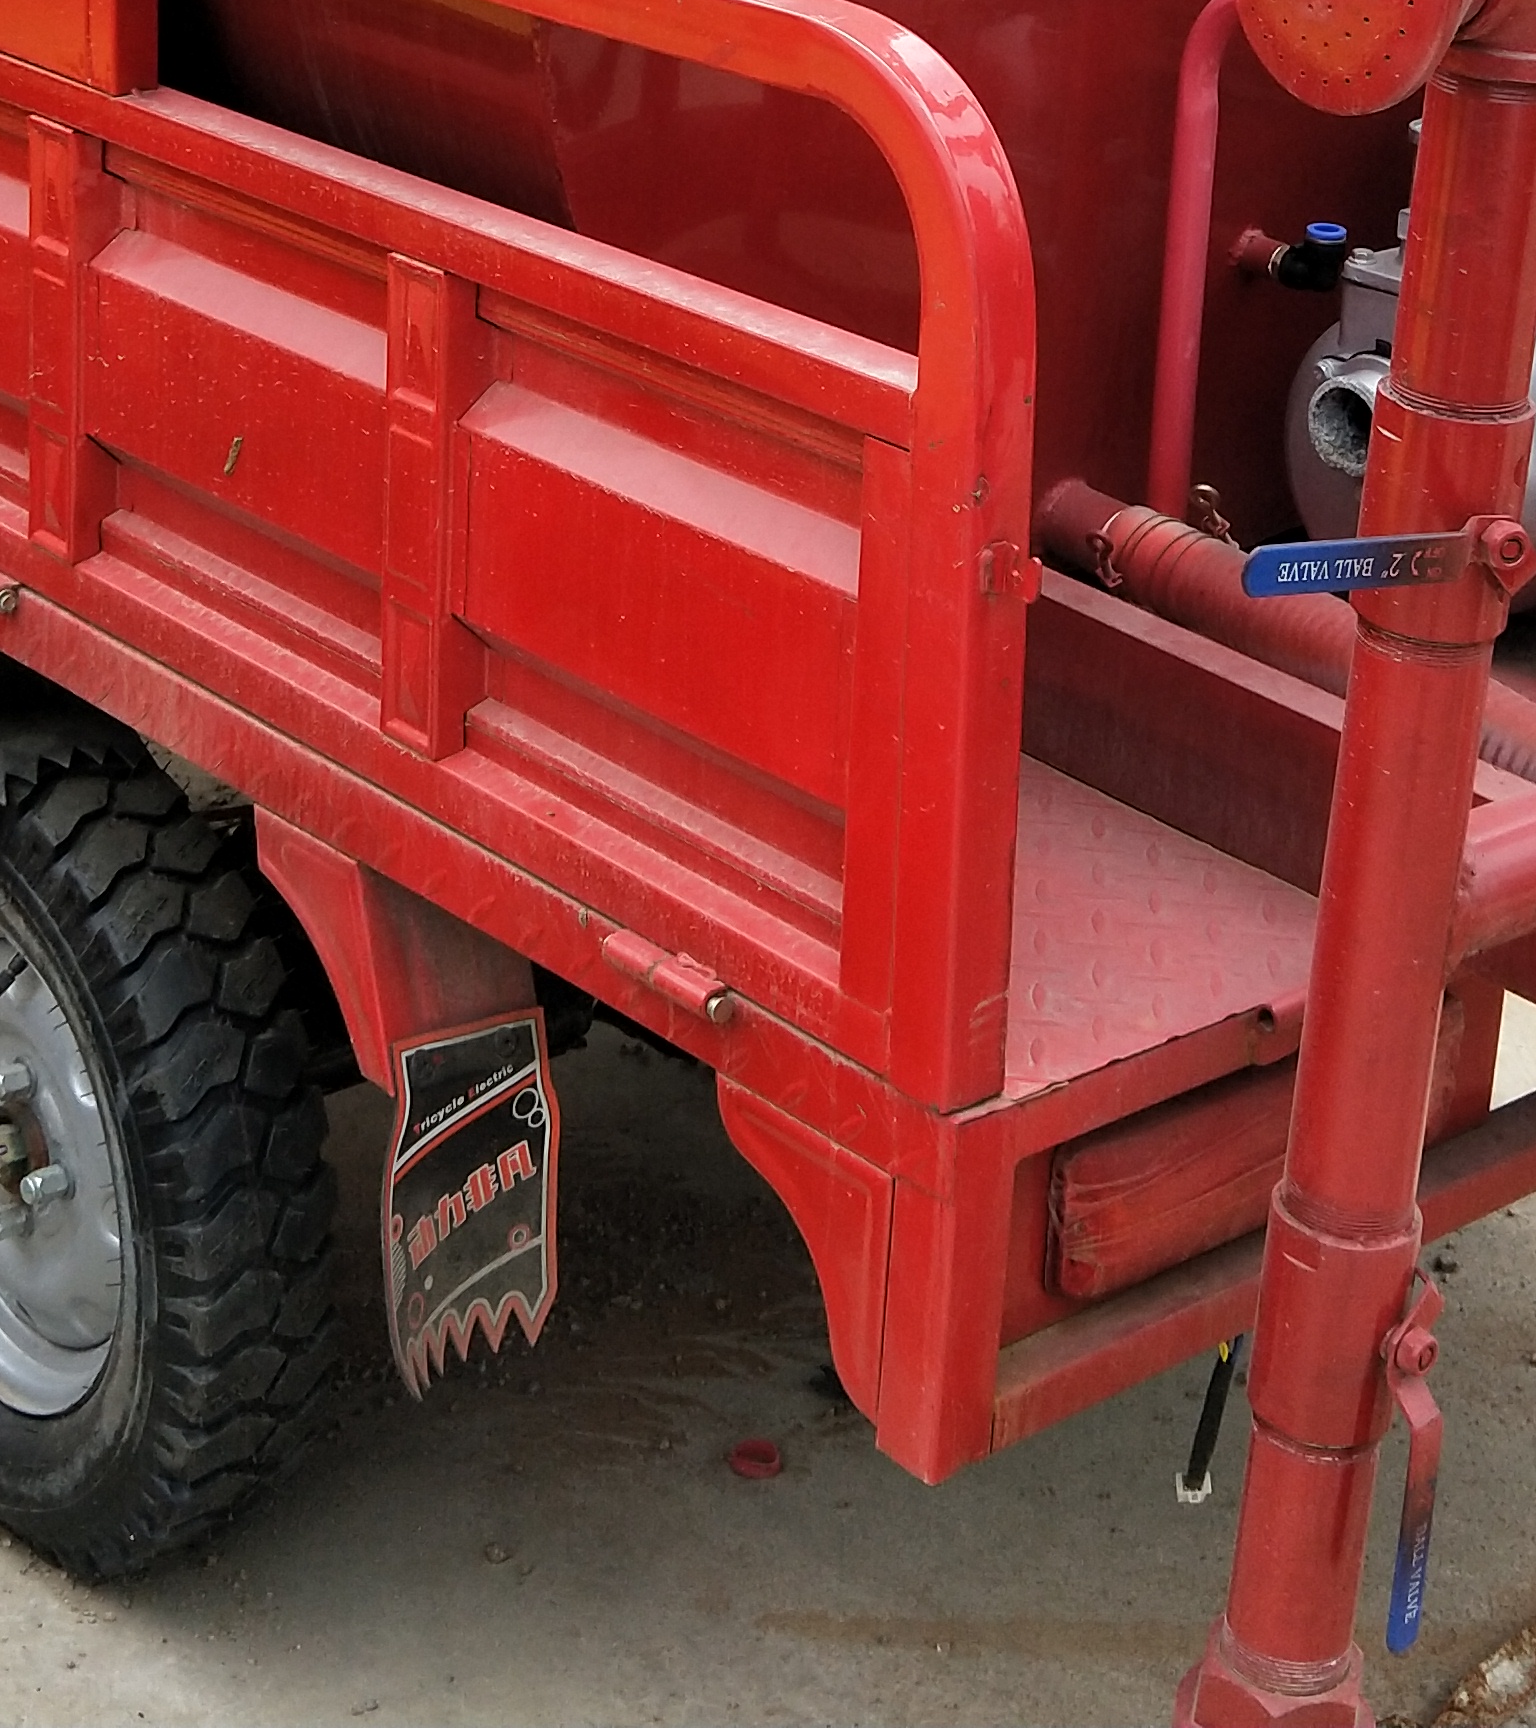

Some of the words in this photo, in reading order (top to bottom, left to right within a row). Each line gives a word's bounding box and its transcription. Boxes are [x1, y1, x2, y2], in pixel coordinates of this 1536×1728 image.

[1278, 560, 1328, 582] VALVE
[1335, 557, 1374, 577] BALL
[413, 1096, 465, 1134] Tricycle
[468, 1064, 514, 1099] Electric
[407, 1140, 537, 1270] 动力非凡
[1404, 1566, 1422, 1624] VALVE
